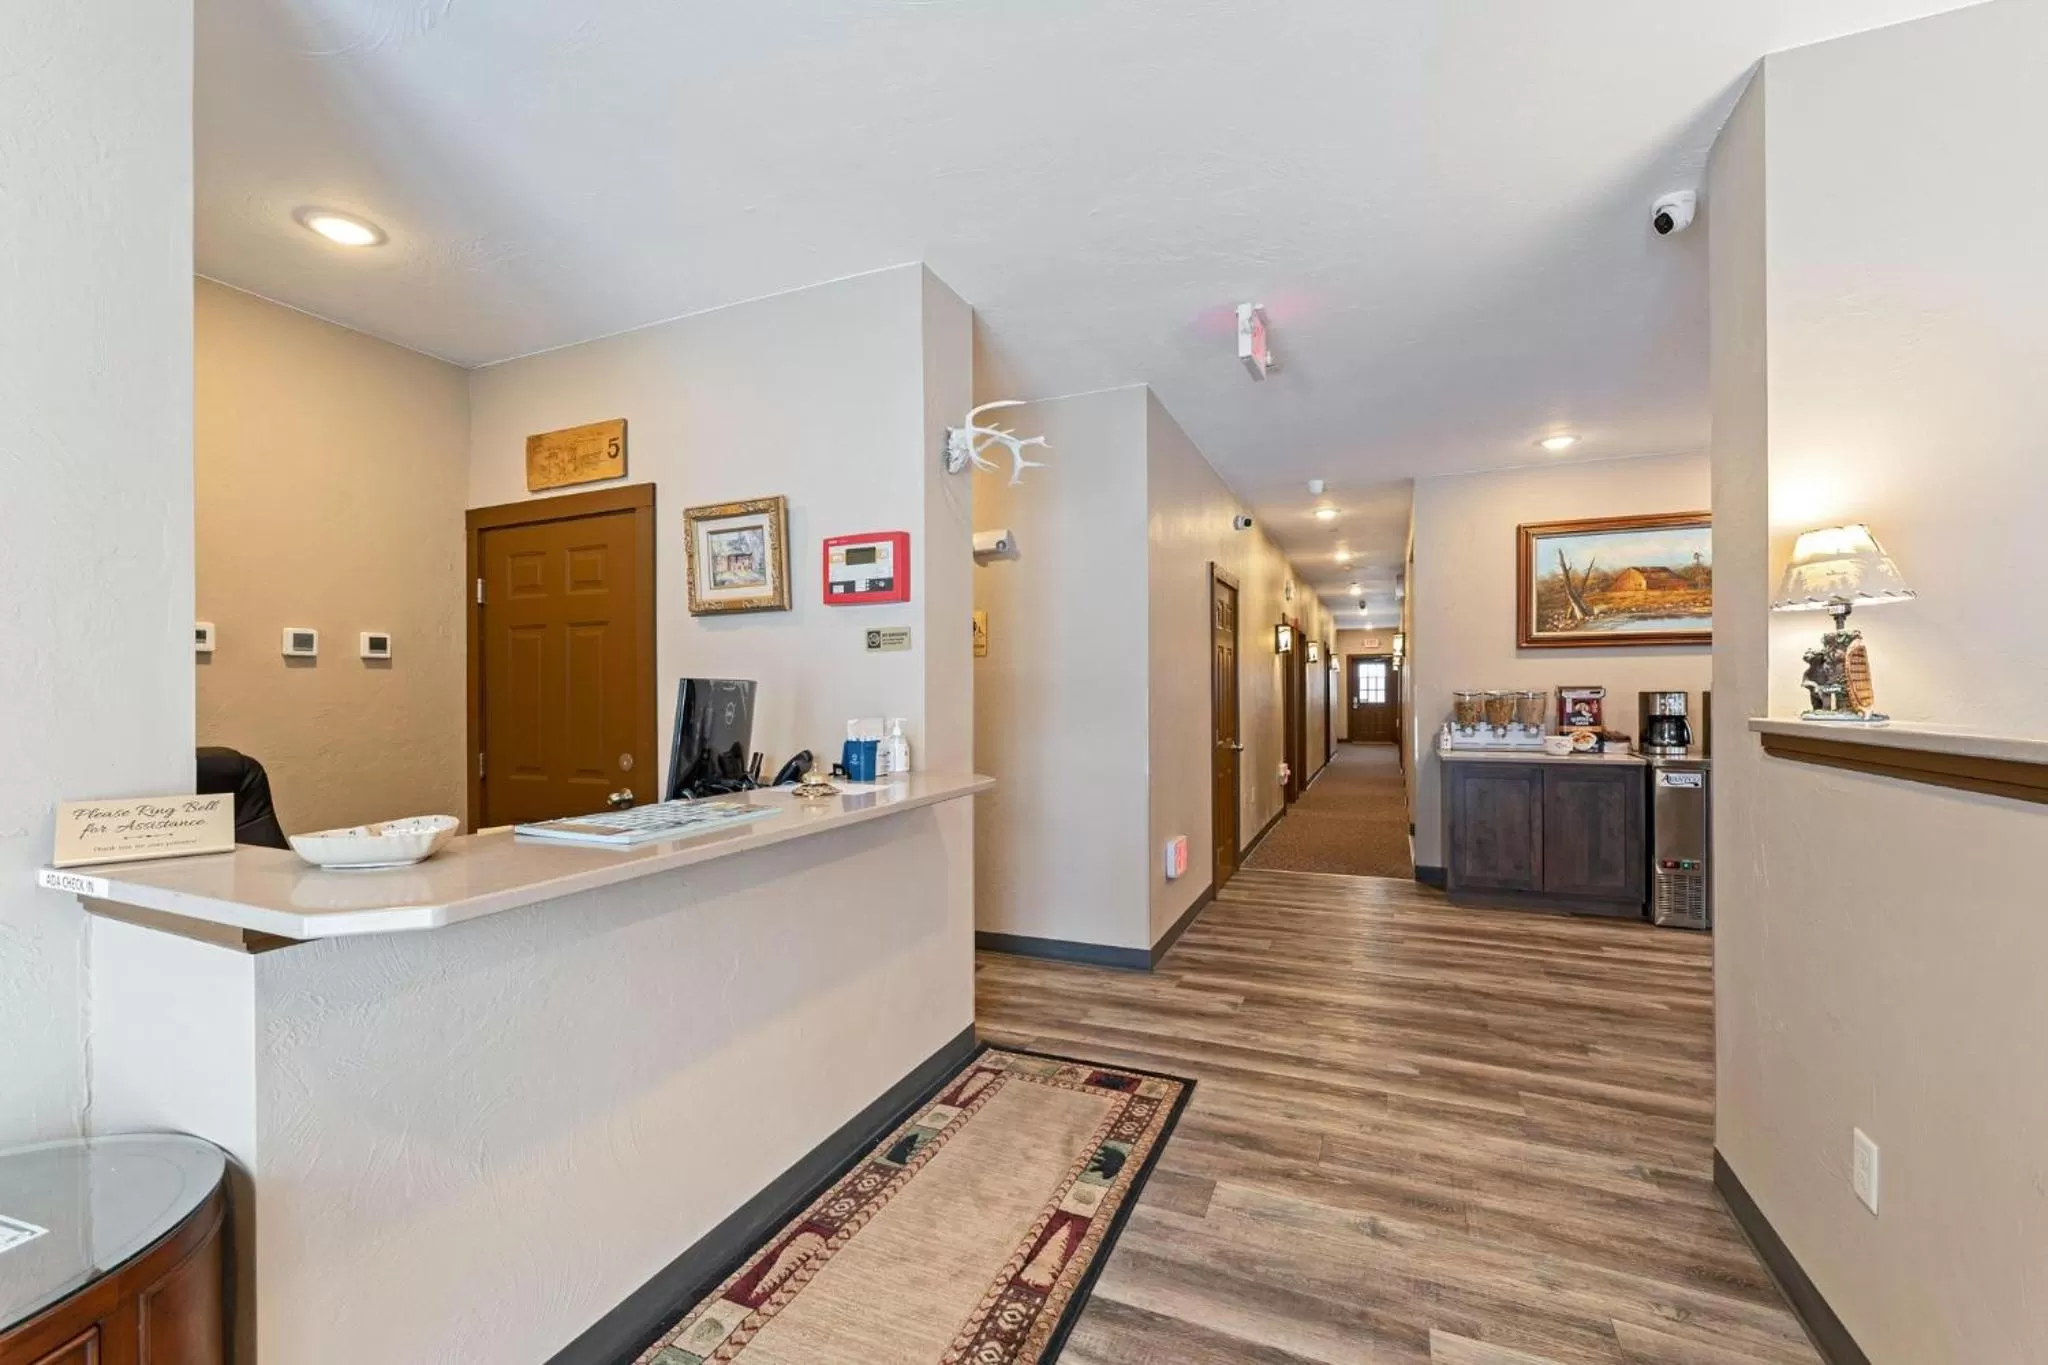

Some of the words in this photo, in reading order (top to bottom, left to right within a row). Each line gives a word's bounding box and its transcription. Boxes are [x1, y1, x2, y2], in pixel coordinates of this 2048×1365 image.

[607, 437, 620, 459] 5
[73, 808, 131, 820] Please
[136, 804, 176, 819] Ring
[183, 800, 220, 813] Bell
[79, 823, 108, 840] for
[116, 819, 206, 833] Assistance
[46, 874, 61, 887] ADA
[62, 876, 86, 891] CHECK
